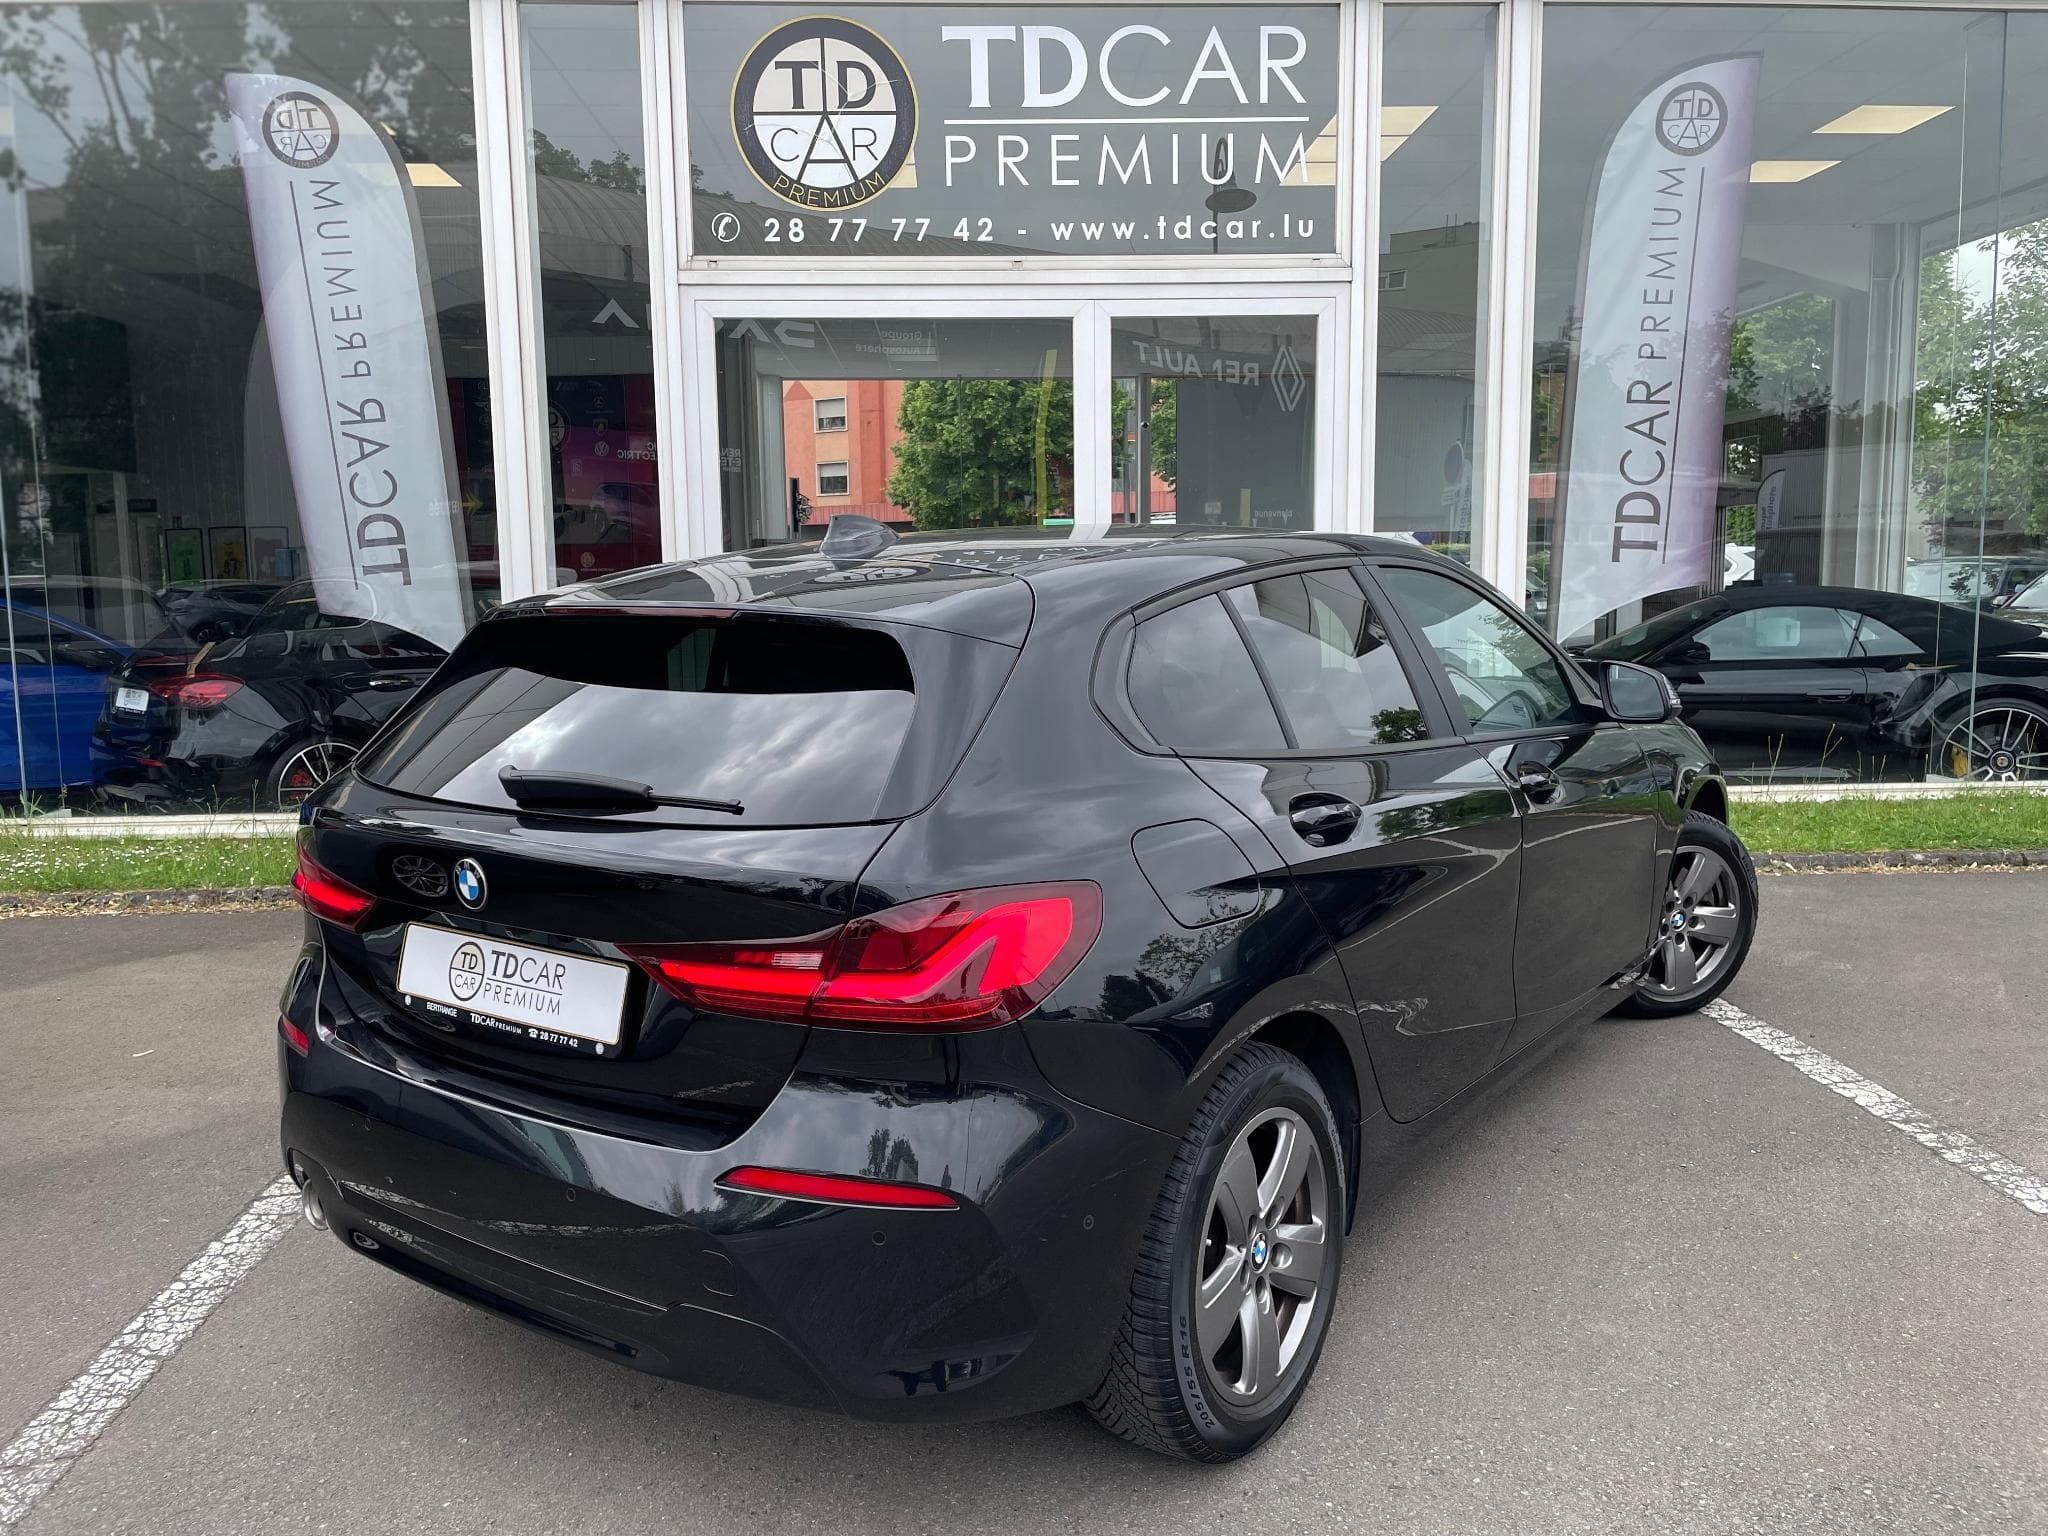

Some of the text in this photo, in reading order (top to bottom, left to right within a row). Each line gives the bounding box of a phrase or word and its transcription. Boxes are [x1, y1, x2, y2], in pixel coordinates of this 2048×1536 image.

[774, 58, 876, 110] TD
[942, 24, 1307, 109] TDCAR
[771, 113, 878, 182] CAR
[945, 133, 1309, 188] PREMIUM
[773, 172, 887, 208] PREMIUM
[764, 219, 805, 244] 28
[828, 219, 867, 243] 77
[892, 218, 929, 243] 77
[953, 218, 994, 242] 42
[1051, 216, 1315, 241] www.tdcar.lu
[1638, 165, 1687, 360] PREMIUM
[1612, 378, 1672, 563] TDCAR
[460, 951, 478, 970] TD
[490, 950, 566, 990] TDCAR
[454, 974, 476, 991] CAR
[483, 982, 561, 1016] PREMIUM
[426, 1001, 457, 1018] BERTRANGE
[539, 1030, 549, 1041] 28
[568, 1037, 578, 1048] 42
